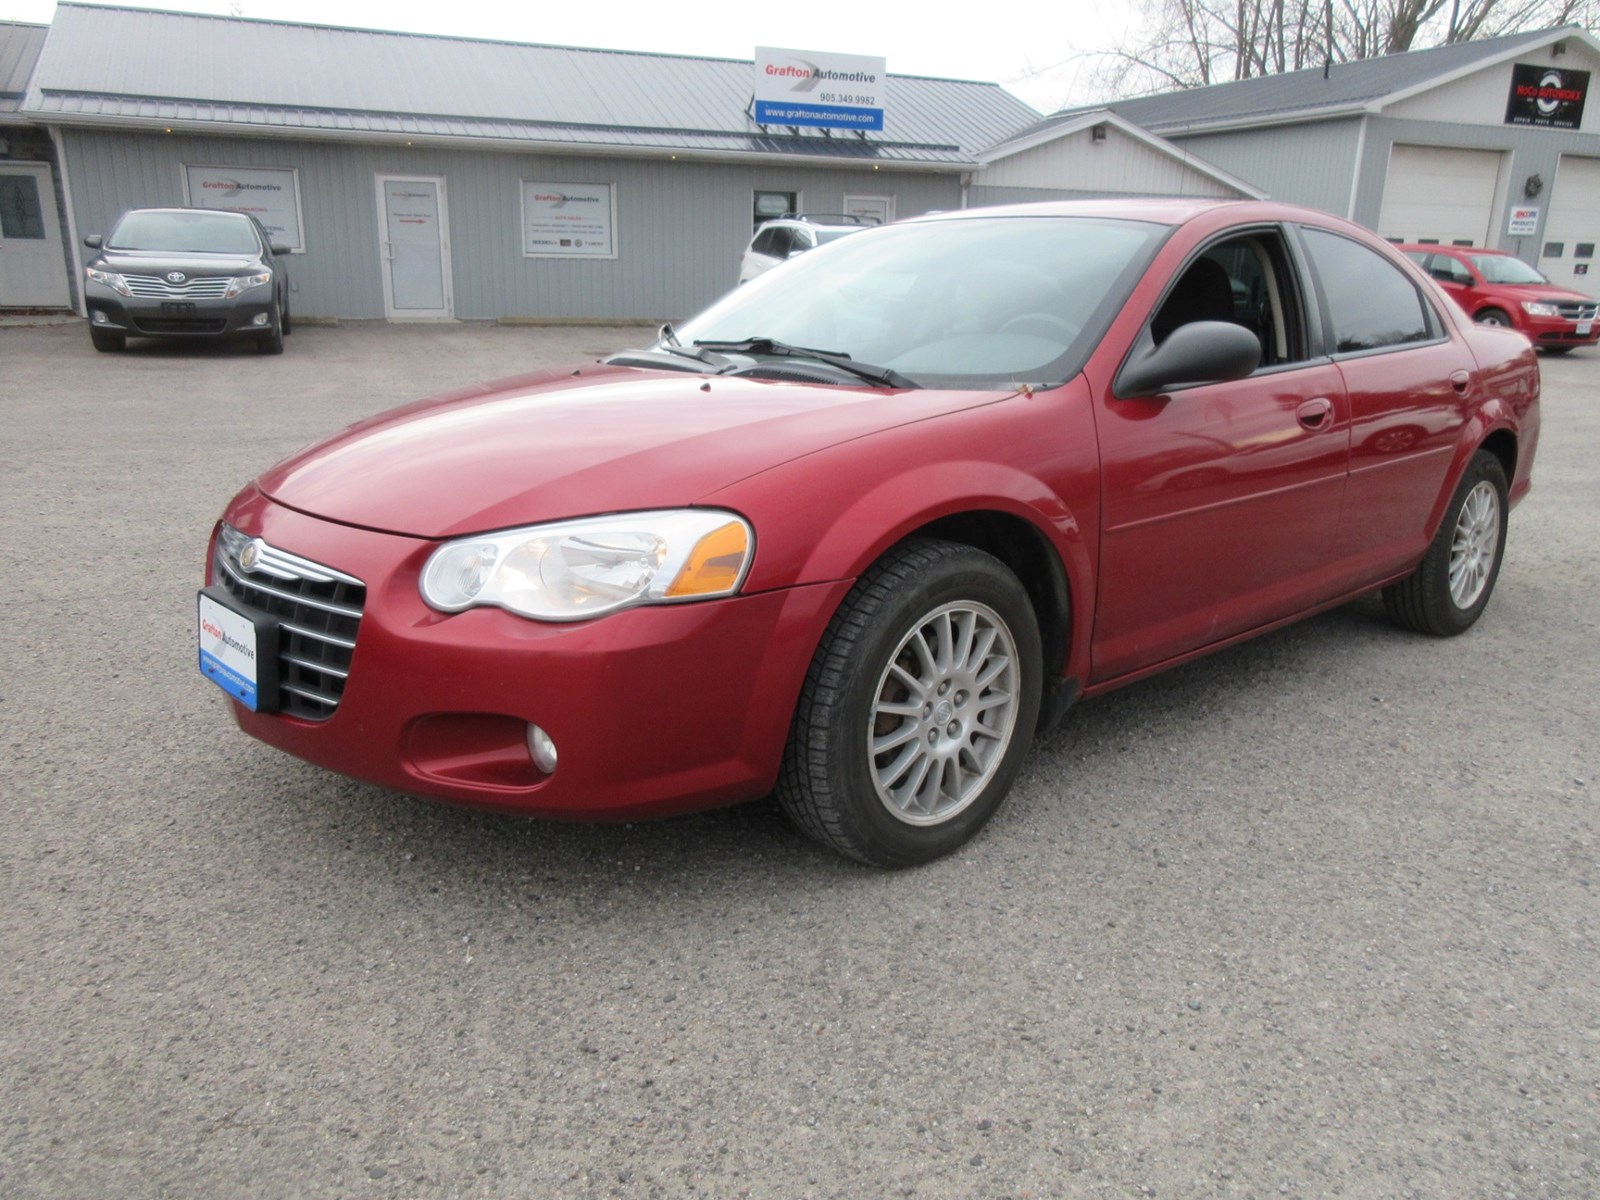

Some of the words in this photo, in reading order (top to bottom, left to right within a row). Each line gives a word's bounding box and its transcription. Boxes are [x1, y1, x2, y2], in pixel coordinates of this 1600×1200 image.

[765, 64, 810, 78] Grafton
[812, 68, 876, 83] Automotive
[765, 108, 875, 123] www.graftonautomotive.com
[202, 181, 235, 190] Grafton
[236, 183, 281, 191] Automotive
[534, 194, 561, 202] Grafton
[562, 195, 600, 203] Automotive
[202, 618, 222, 640] Grafton
[222, 631, 255, 660] Automotive
